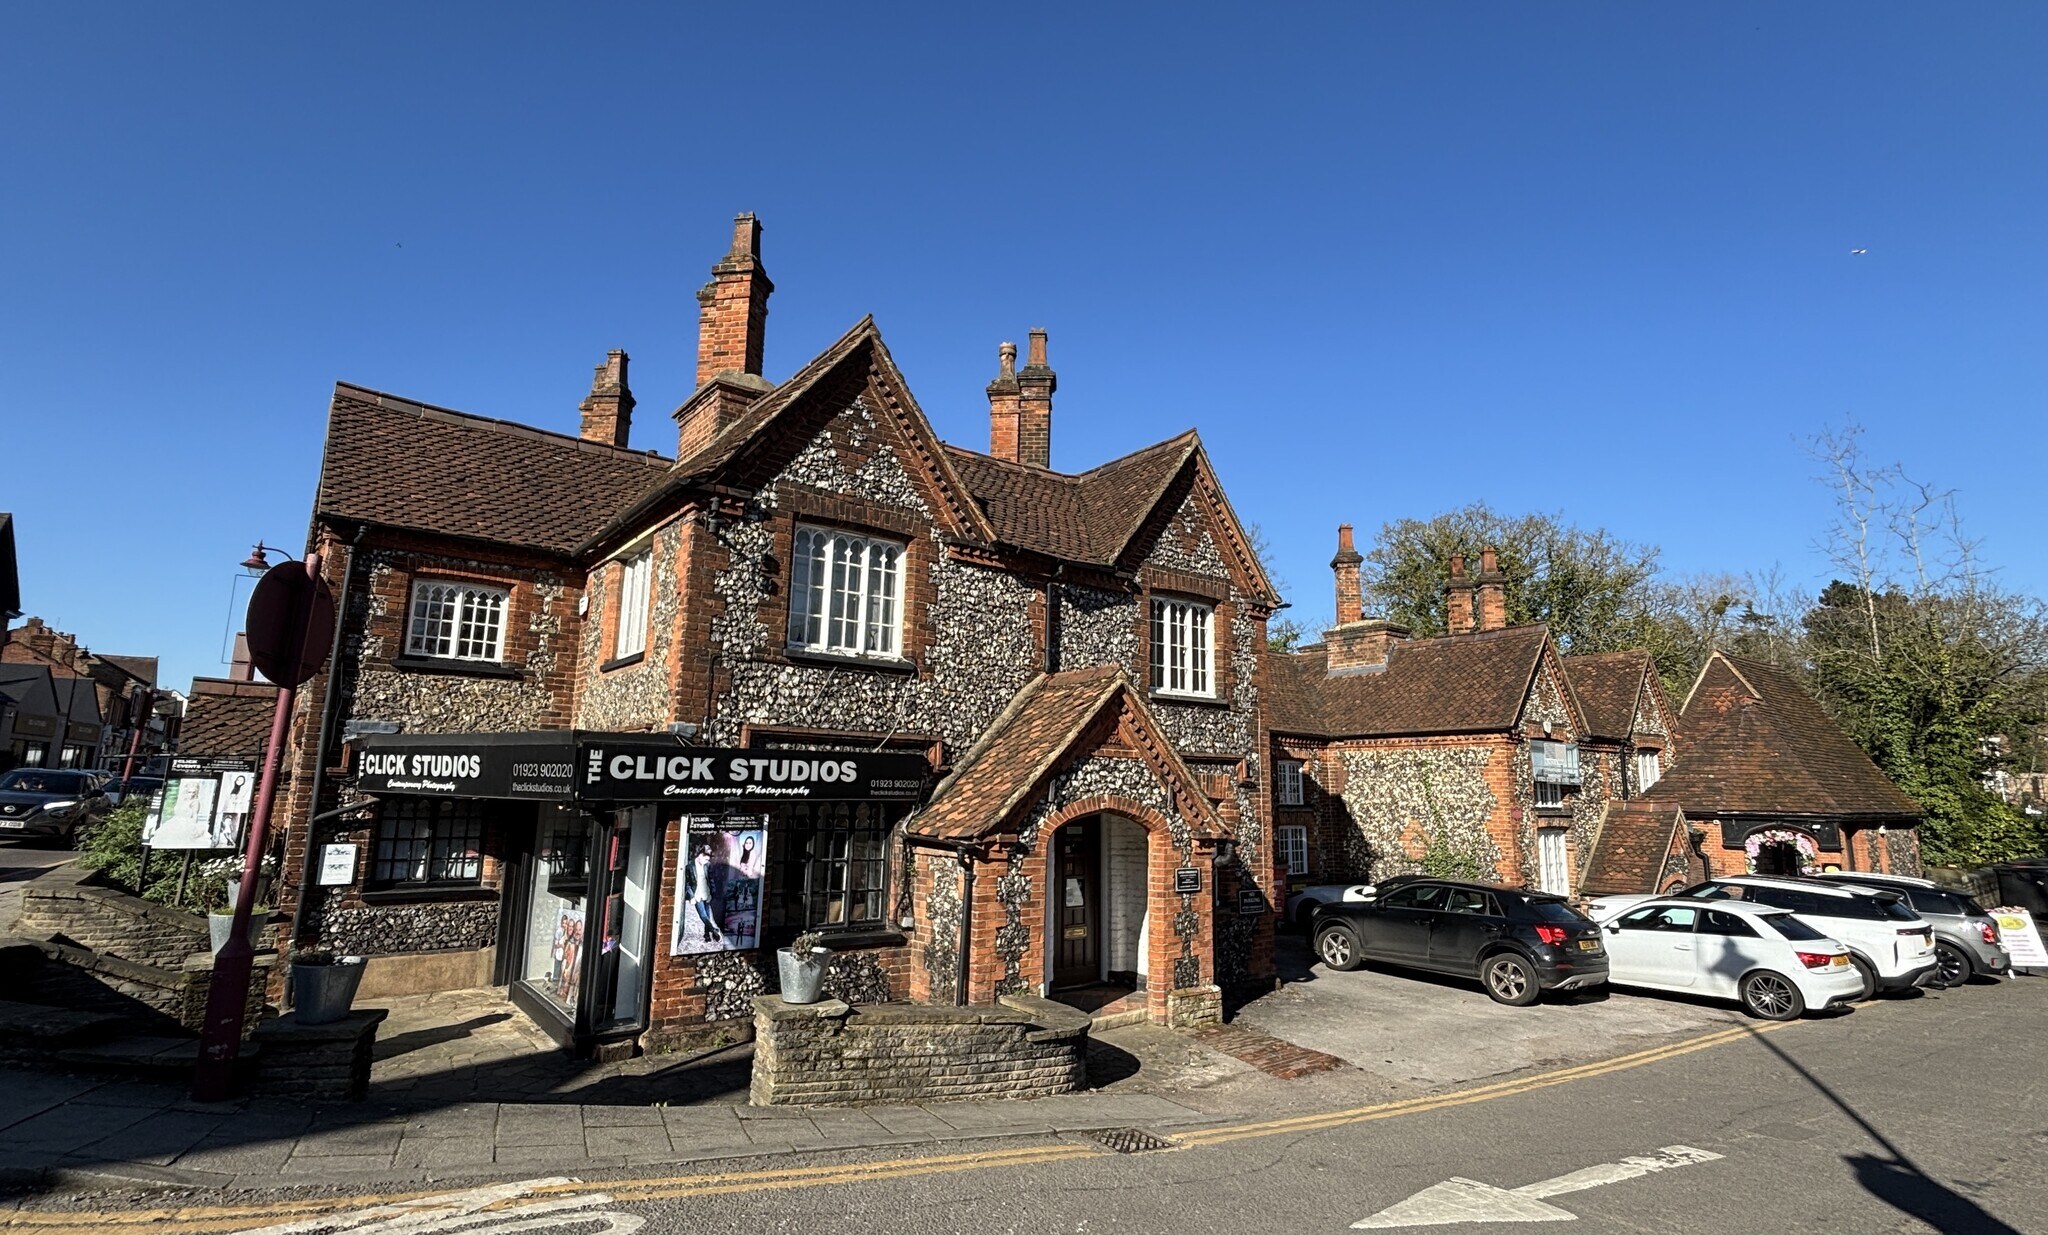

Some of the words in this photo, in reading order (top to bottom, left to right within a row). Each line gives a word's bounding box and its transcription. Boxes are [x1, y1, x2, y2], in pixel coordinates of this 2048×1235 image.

[366, 754, 407, 776] CLICK
[412, 754, 481, 779] STUDIOS
[512, 763, 539, 777] 01923
[540, 763, 574, 778] 902020
[587, 749, 603, 785] THE
[609, 755, 715, 781] CLICK
[729, 758, 858, 783] STUDIOS
[387, 779, 421, 790] Contemporary
[422, 779, 456, 792] Photography
[512, 782, 572, 794] theclickstudios.co.uk
[870, 779, 893, 788] 01923
[894, 780, 920, 788] 902020
[663, 784, 744, 797] Contemporary
[746, 784, 810, 797] Photography
